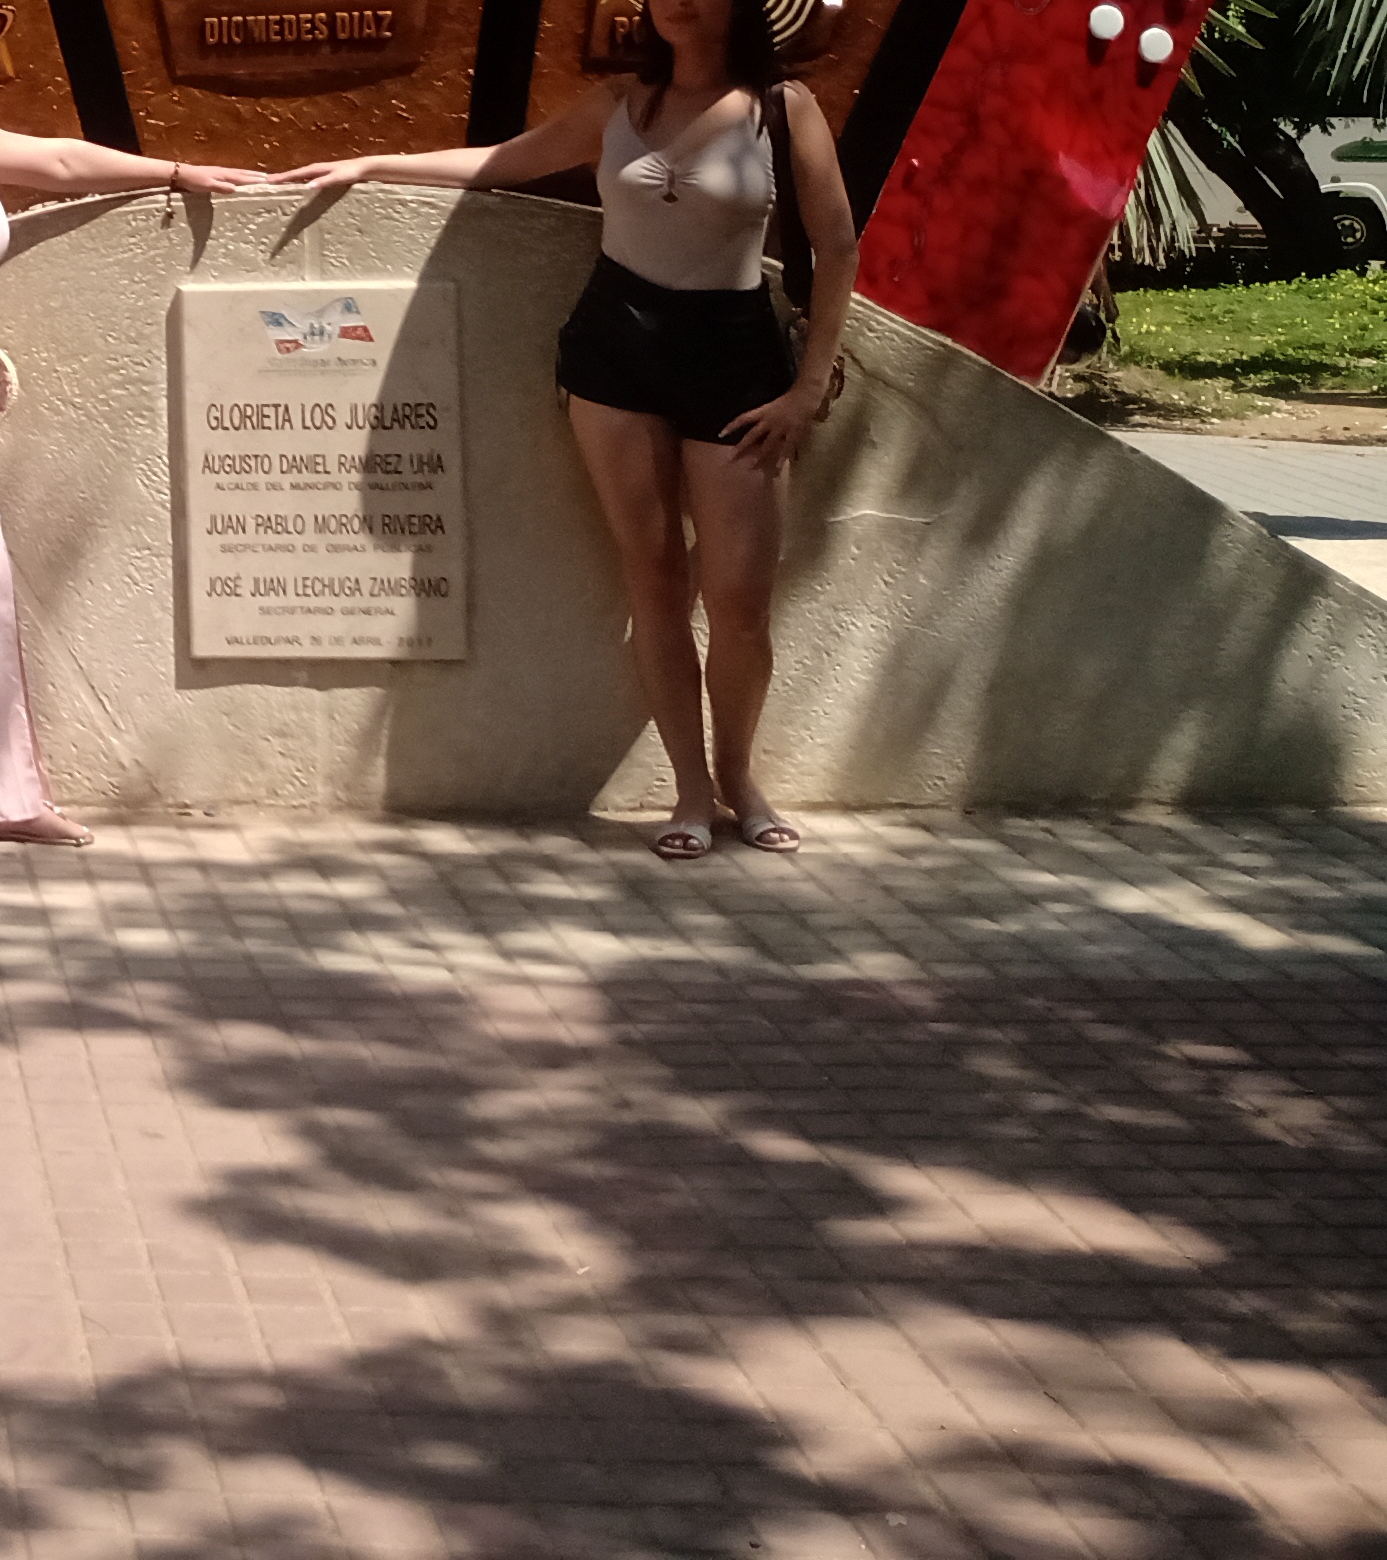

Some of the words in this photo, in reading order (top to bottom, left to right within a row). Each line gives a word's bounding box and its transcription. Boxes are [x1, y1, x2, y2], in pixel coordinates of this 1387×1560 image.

[204, 12, 327, 45] DIOMEDES
[336, 10, 393, 39] DIAZ
[206, 402, 294, 431] GLORIETA
[301, 402, 337, 431] LOS
[345, 401, 438, 431] JUGLARES
[201, 453, 272, 475] AUGUSTO
[279, 453, 331, 475] DANIEL
[214, 481, 259, 491] ALCALDE
[265, 481, 284, 491] DEL
[206, 513, 247, 536] JUAN
[254, 513, 306, 536] PABLO
[381, 513, 446, 536] RIVEIRA
[219, 543, 296, 554] SECRETARIO
[302, 543, 318, 554] DE
[249, 576, 288, 598] JUAN
[293, 576, 364, 598] LECHUGA
[369, 576, 449, 598] ZAMBRANO
[258, 605, 334, 616] SECRETARIO
[340, 605, 397, 616] GENERAL
